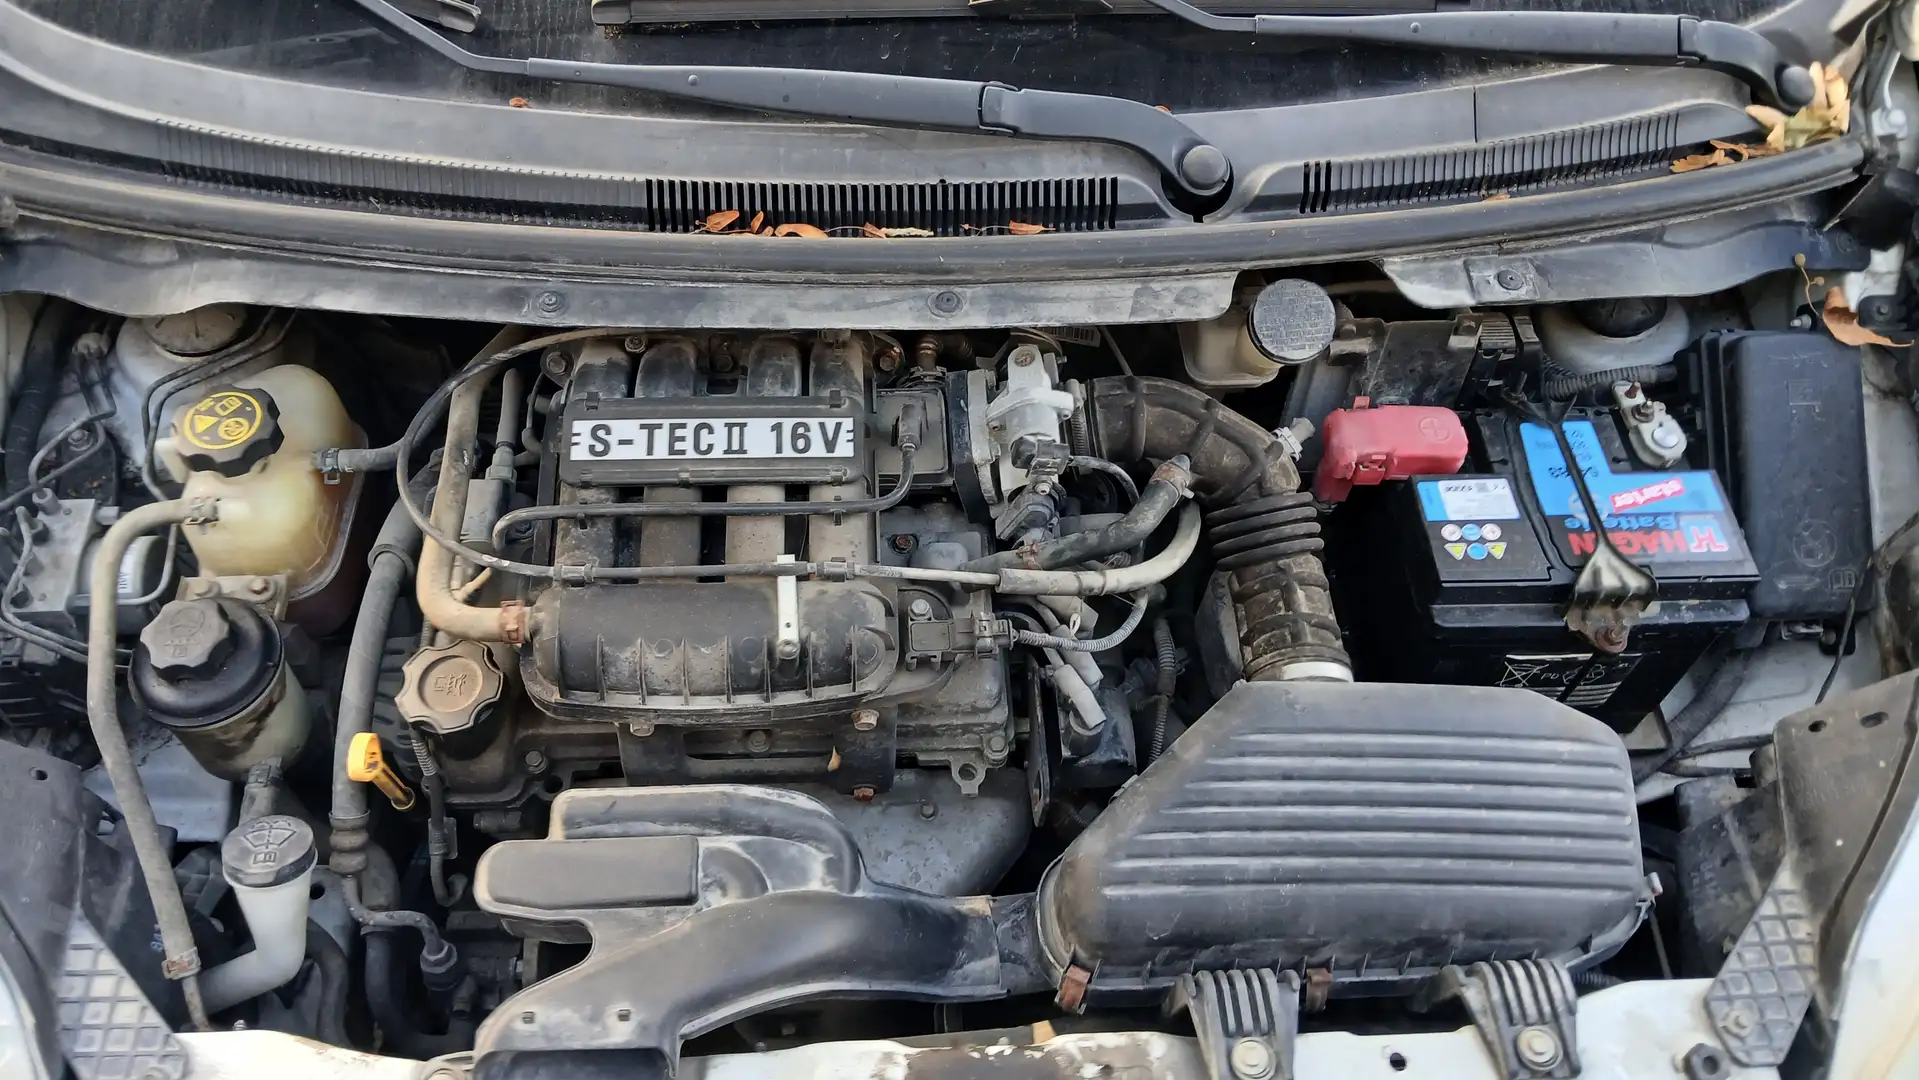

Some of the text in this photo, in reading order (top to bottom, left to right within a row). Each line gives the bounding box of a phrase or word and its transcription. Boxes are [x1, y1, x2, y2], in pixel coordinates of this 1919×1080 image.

[770, 421, 843, 455] 16V
[1613, 480, 1681, 506] starter
[1564, 515, 1677, 532] Batteie
[1568, 530, 1687, 555] HAGN
